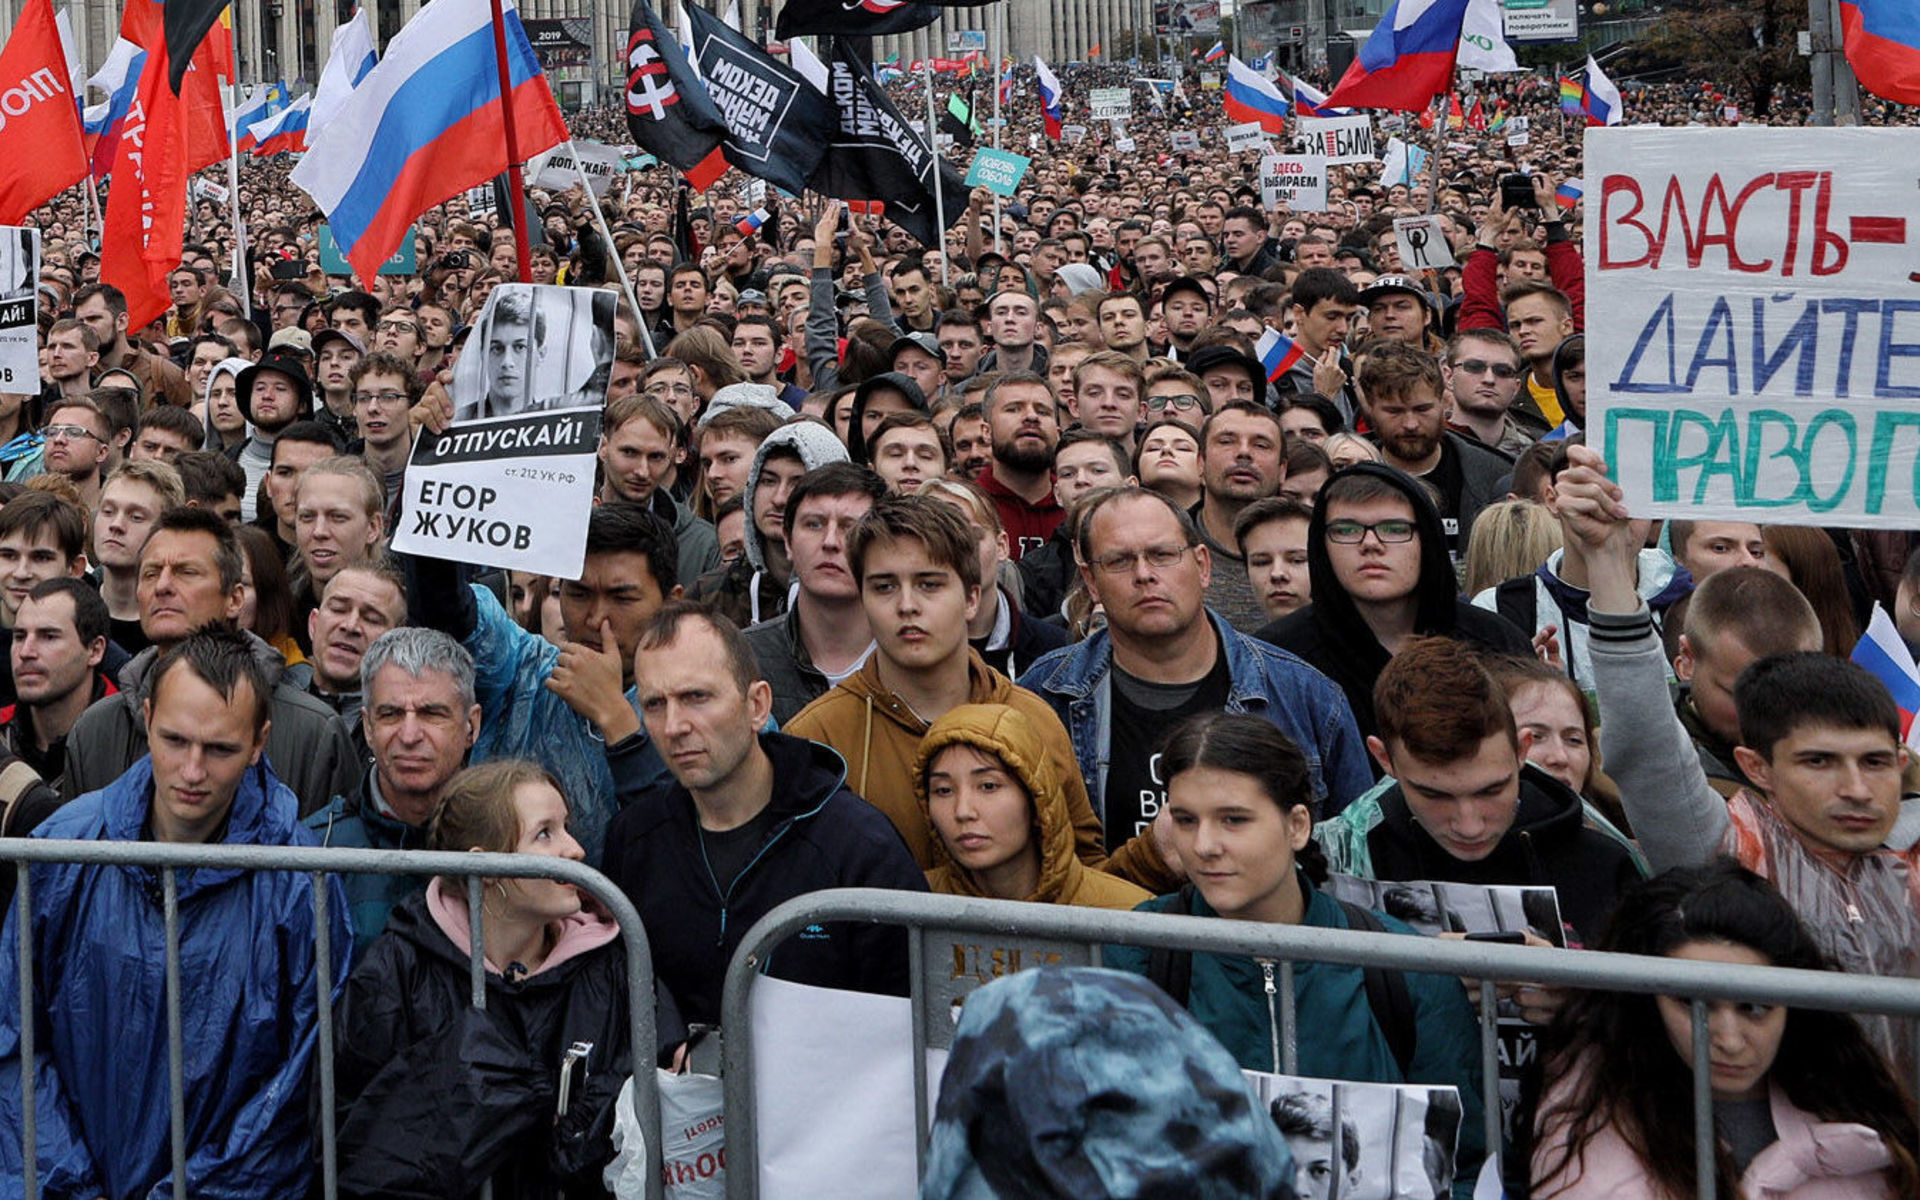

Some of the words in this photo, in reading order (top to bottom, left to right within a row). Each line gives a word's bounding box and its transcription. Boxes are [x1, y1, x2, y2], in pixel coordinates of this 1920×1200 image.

[538, 31, 562, 40] 2019
[1273, 162, 1304, 175] ЗДЕСЬ
[1264, 176, 1318, 188] ВЫБИРАЕМ
[1609, 292, 1920, 398] ДАЙТЕ
[435, 416, 583, 457] ОТПУСКАЙ!
[520, 467, 537, 479] 212
[540, 471, 556, 482] УК
[558, 473, 577, 485] РФ
[419, 480, 497, 512] ЕГОР
[412, 510, 532, 550] ЖУКОВ
